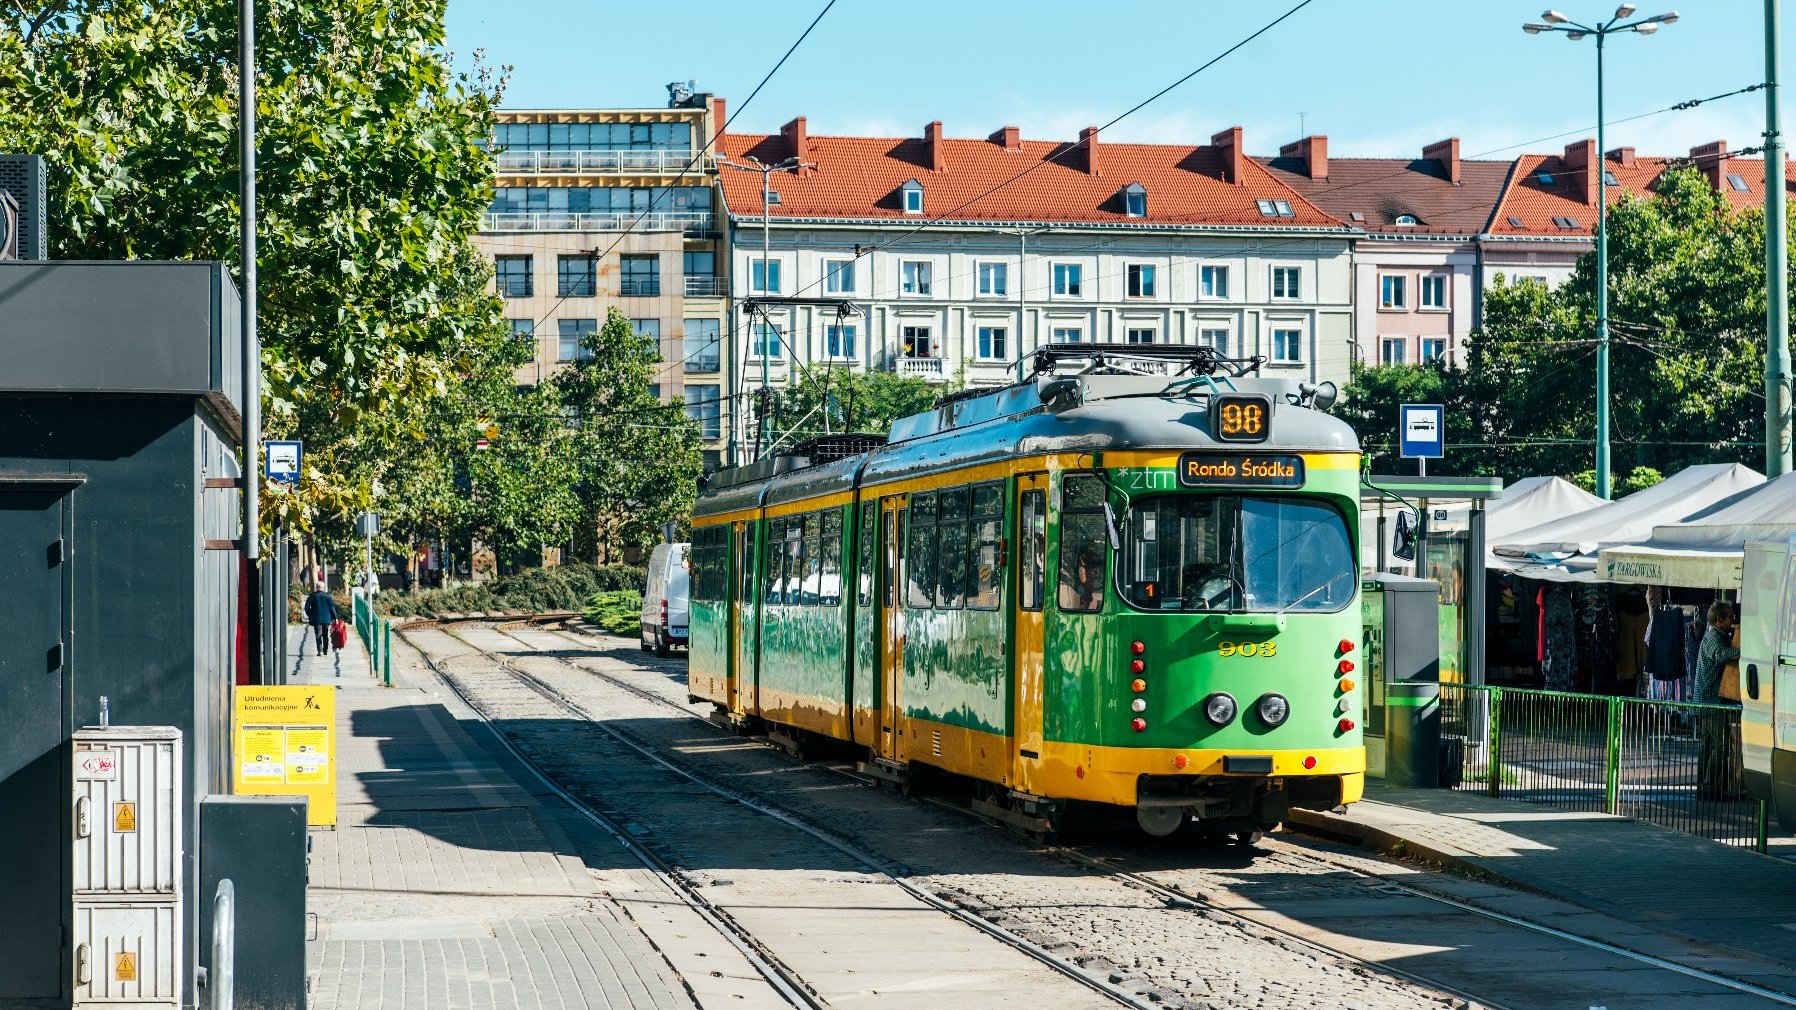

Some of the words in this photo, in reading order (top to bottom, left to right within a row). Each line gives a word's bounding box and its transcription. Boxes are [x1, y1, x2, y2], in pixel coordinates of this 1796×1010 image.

[1223, 403, 1262, 434] 98
[1188, 461, 1236, 477] Rondo
[1241, 458, 1295, 477] Śródka
[1145, 584, 1154, 597] 1
[1218, 641, 1277, 657] 903
[244, 704, 298, 712] komunikacyjne
